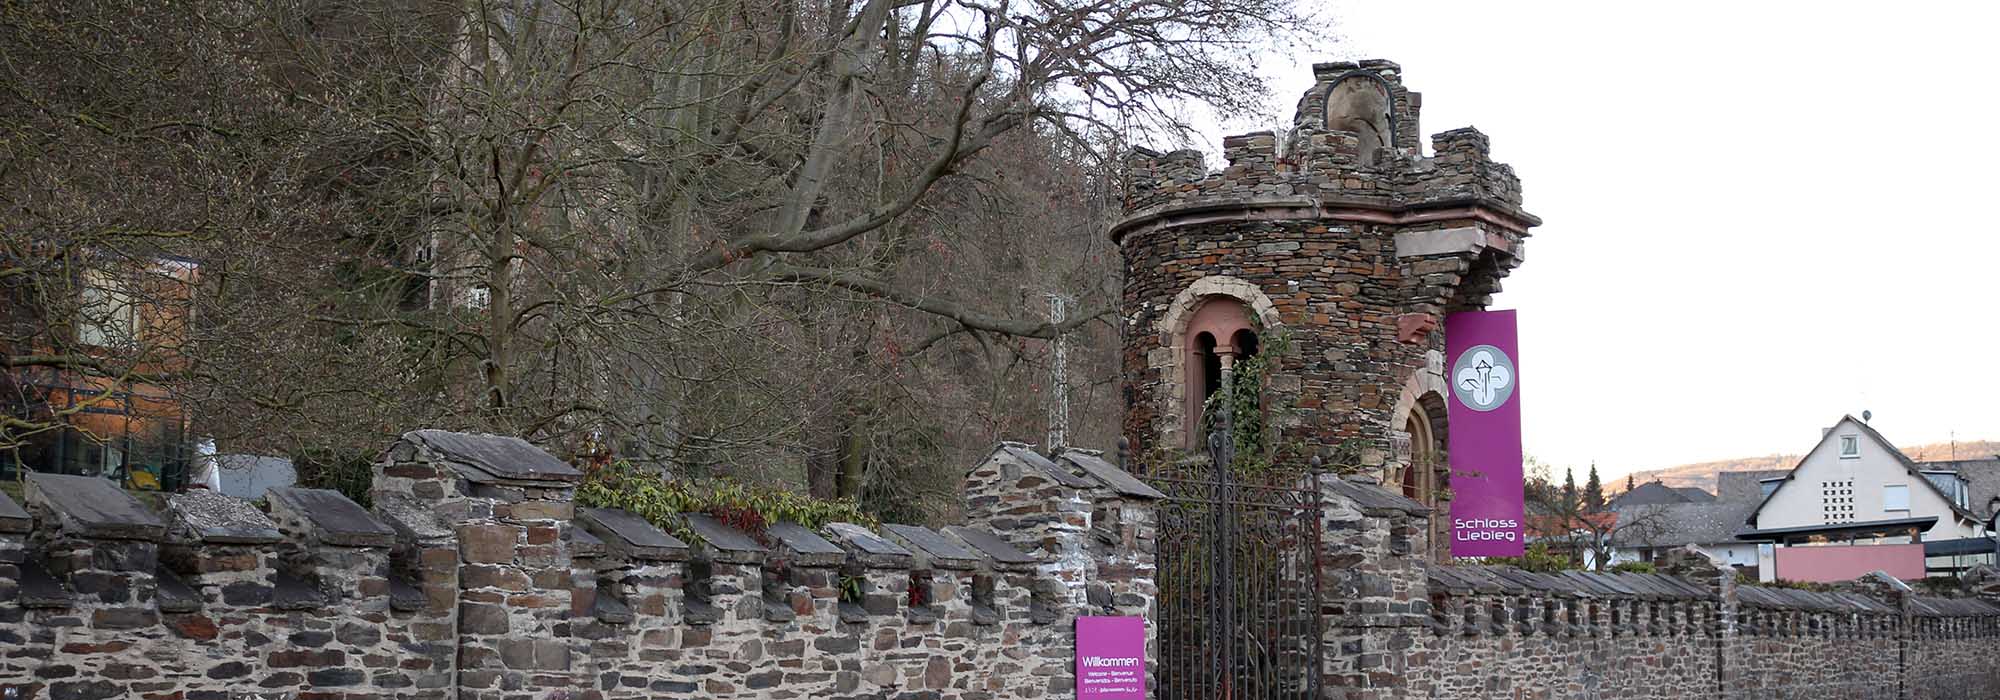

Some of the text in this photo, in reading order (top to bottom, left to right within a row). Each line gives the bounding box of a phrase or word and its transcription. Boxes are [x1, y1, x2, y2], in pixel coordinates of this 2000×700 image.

[1455, 518, 1518, 529] Schloss
[1457, 530, 1516, 542] Liebieg
[1082, 656, 1139, 667] Willkommen
